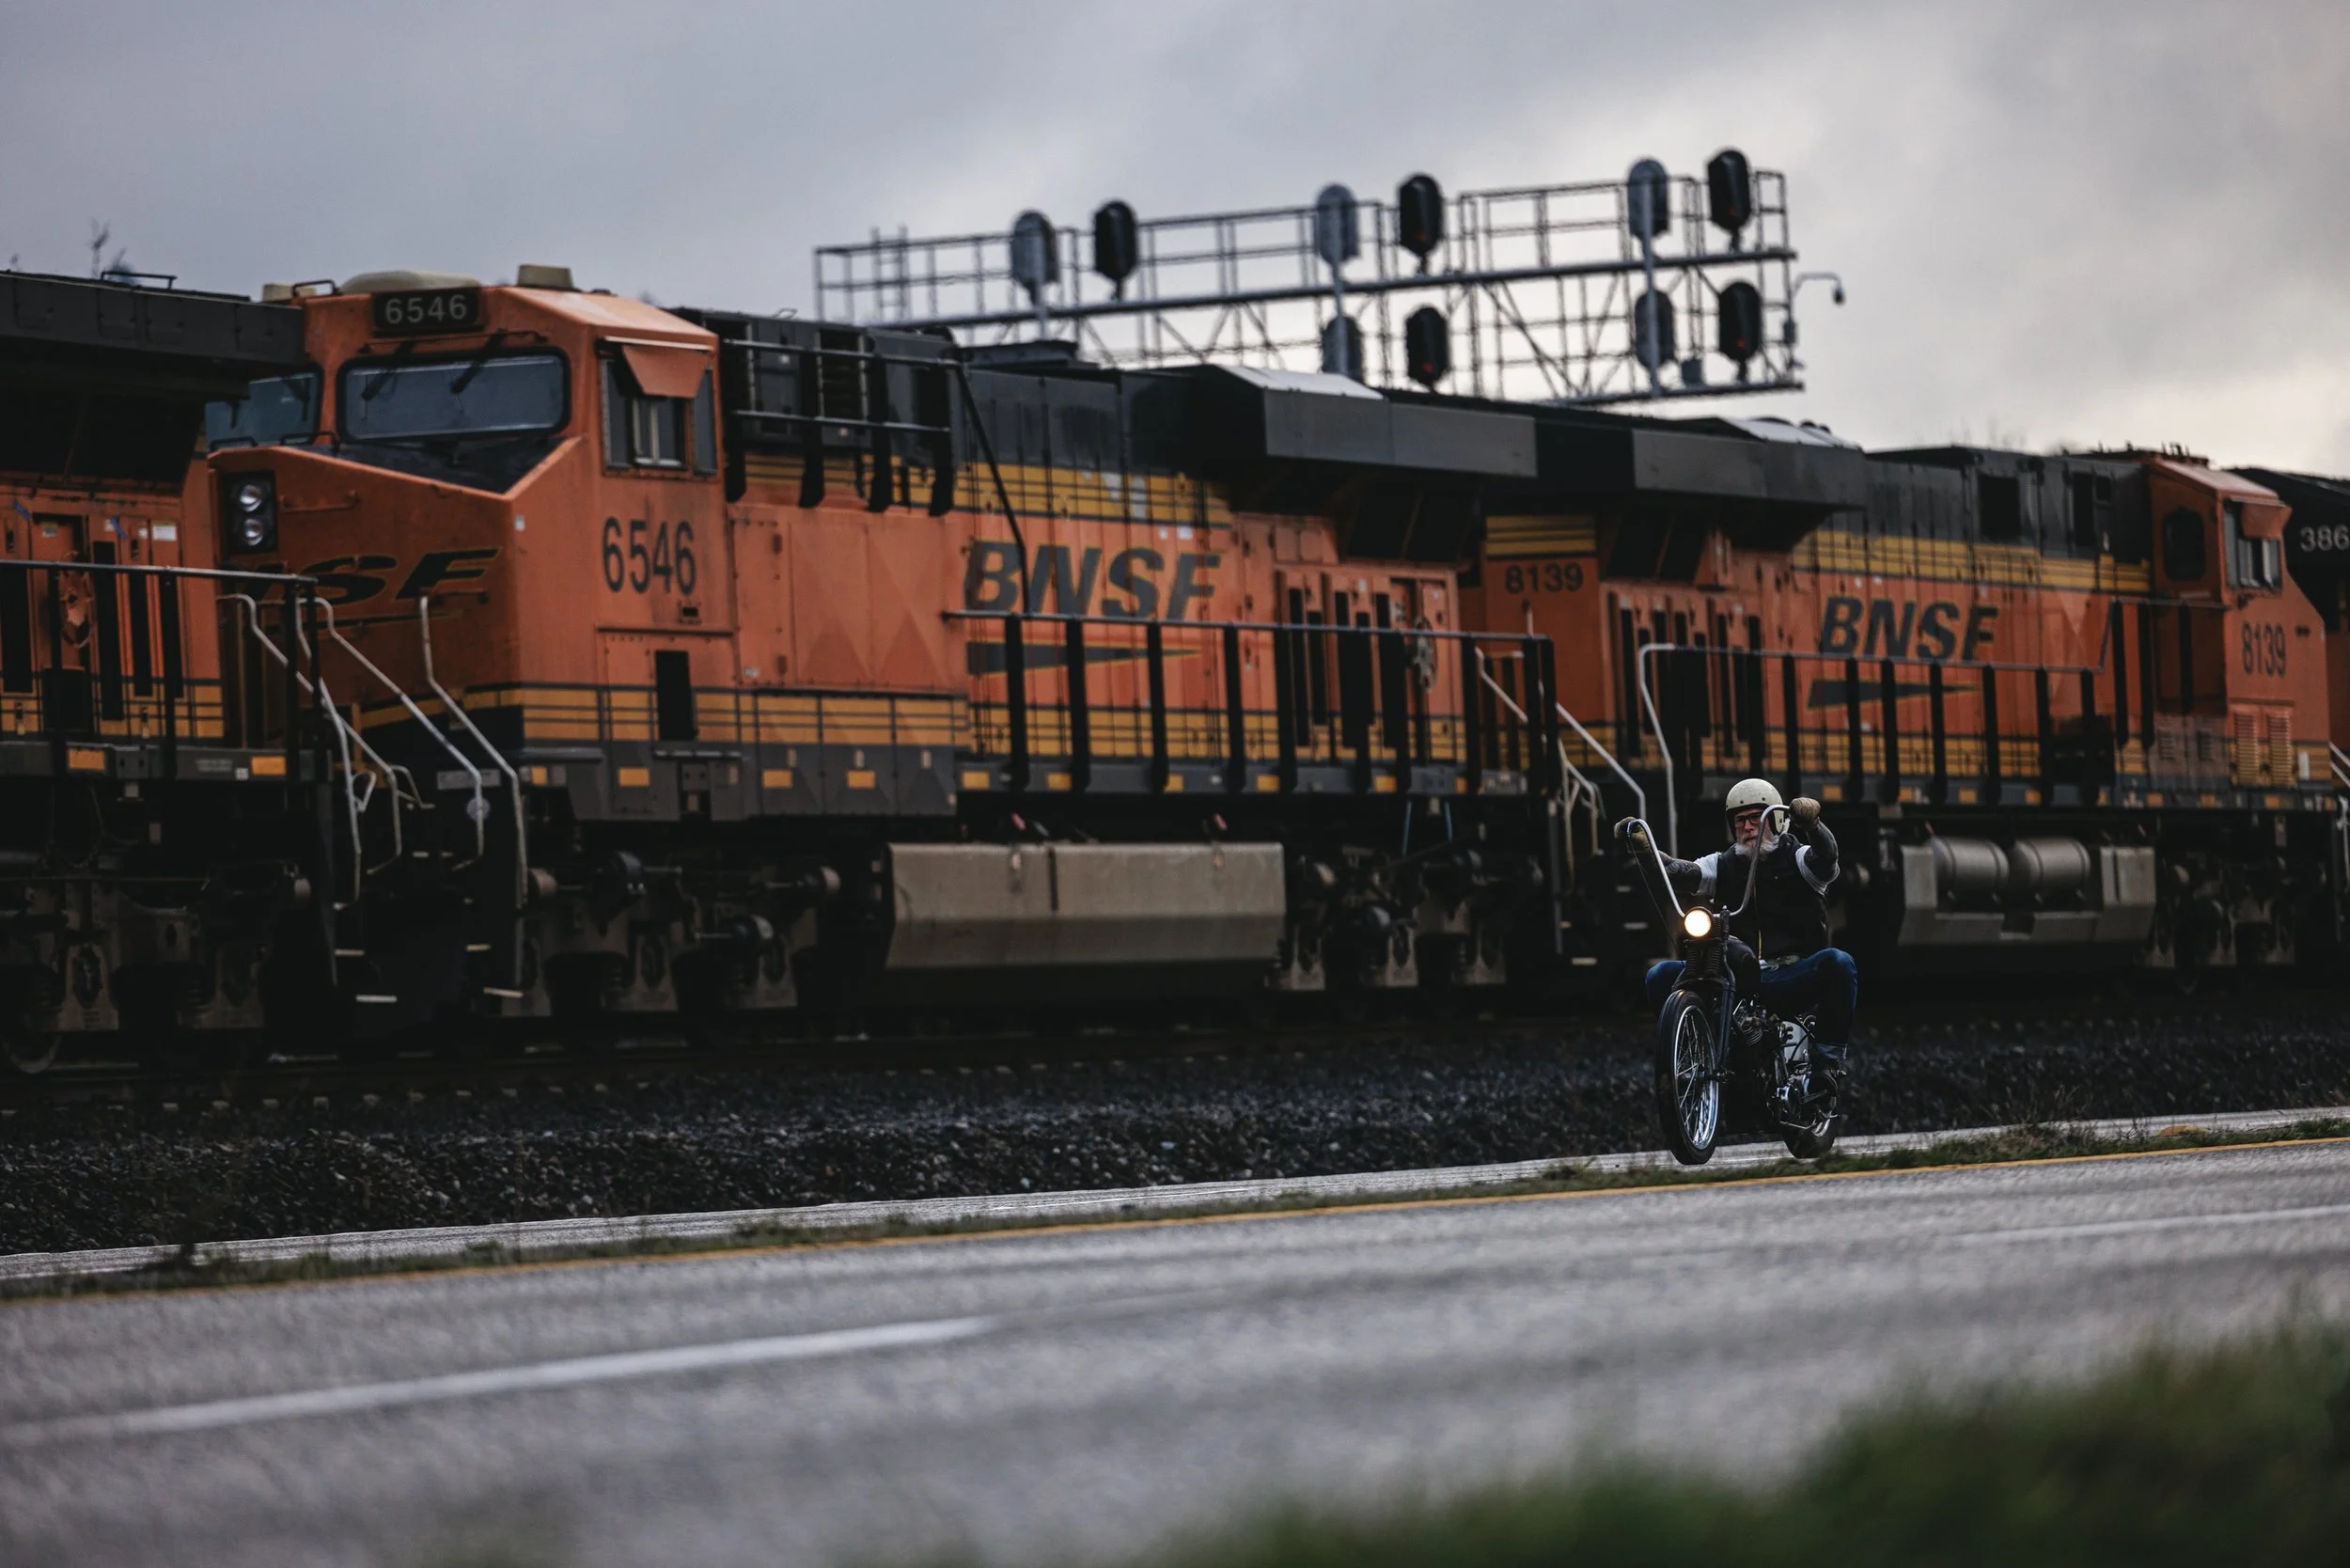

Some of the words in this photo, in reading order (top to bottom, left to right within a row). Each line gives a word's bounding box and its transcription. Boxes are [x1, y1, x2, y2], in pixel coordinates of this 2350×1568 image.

[385, 294, 467, 324] 6546
[603, 517, 697, 595] 6546
[2300, 525, 2350, 552] 386
[964, 540, 1221, 621] BNSF
[1506, 563, 1584, 594] 8139
[1820, 595, 1999, 661] BNSF
[2241, 621, 2286, 678] 8139
